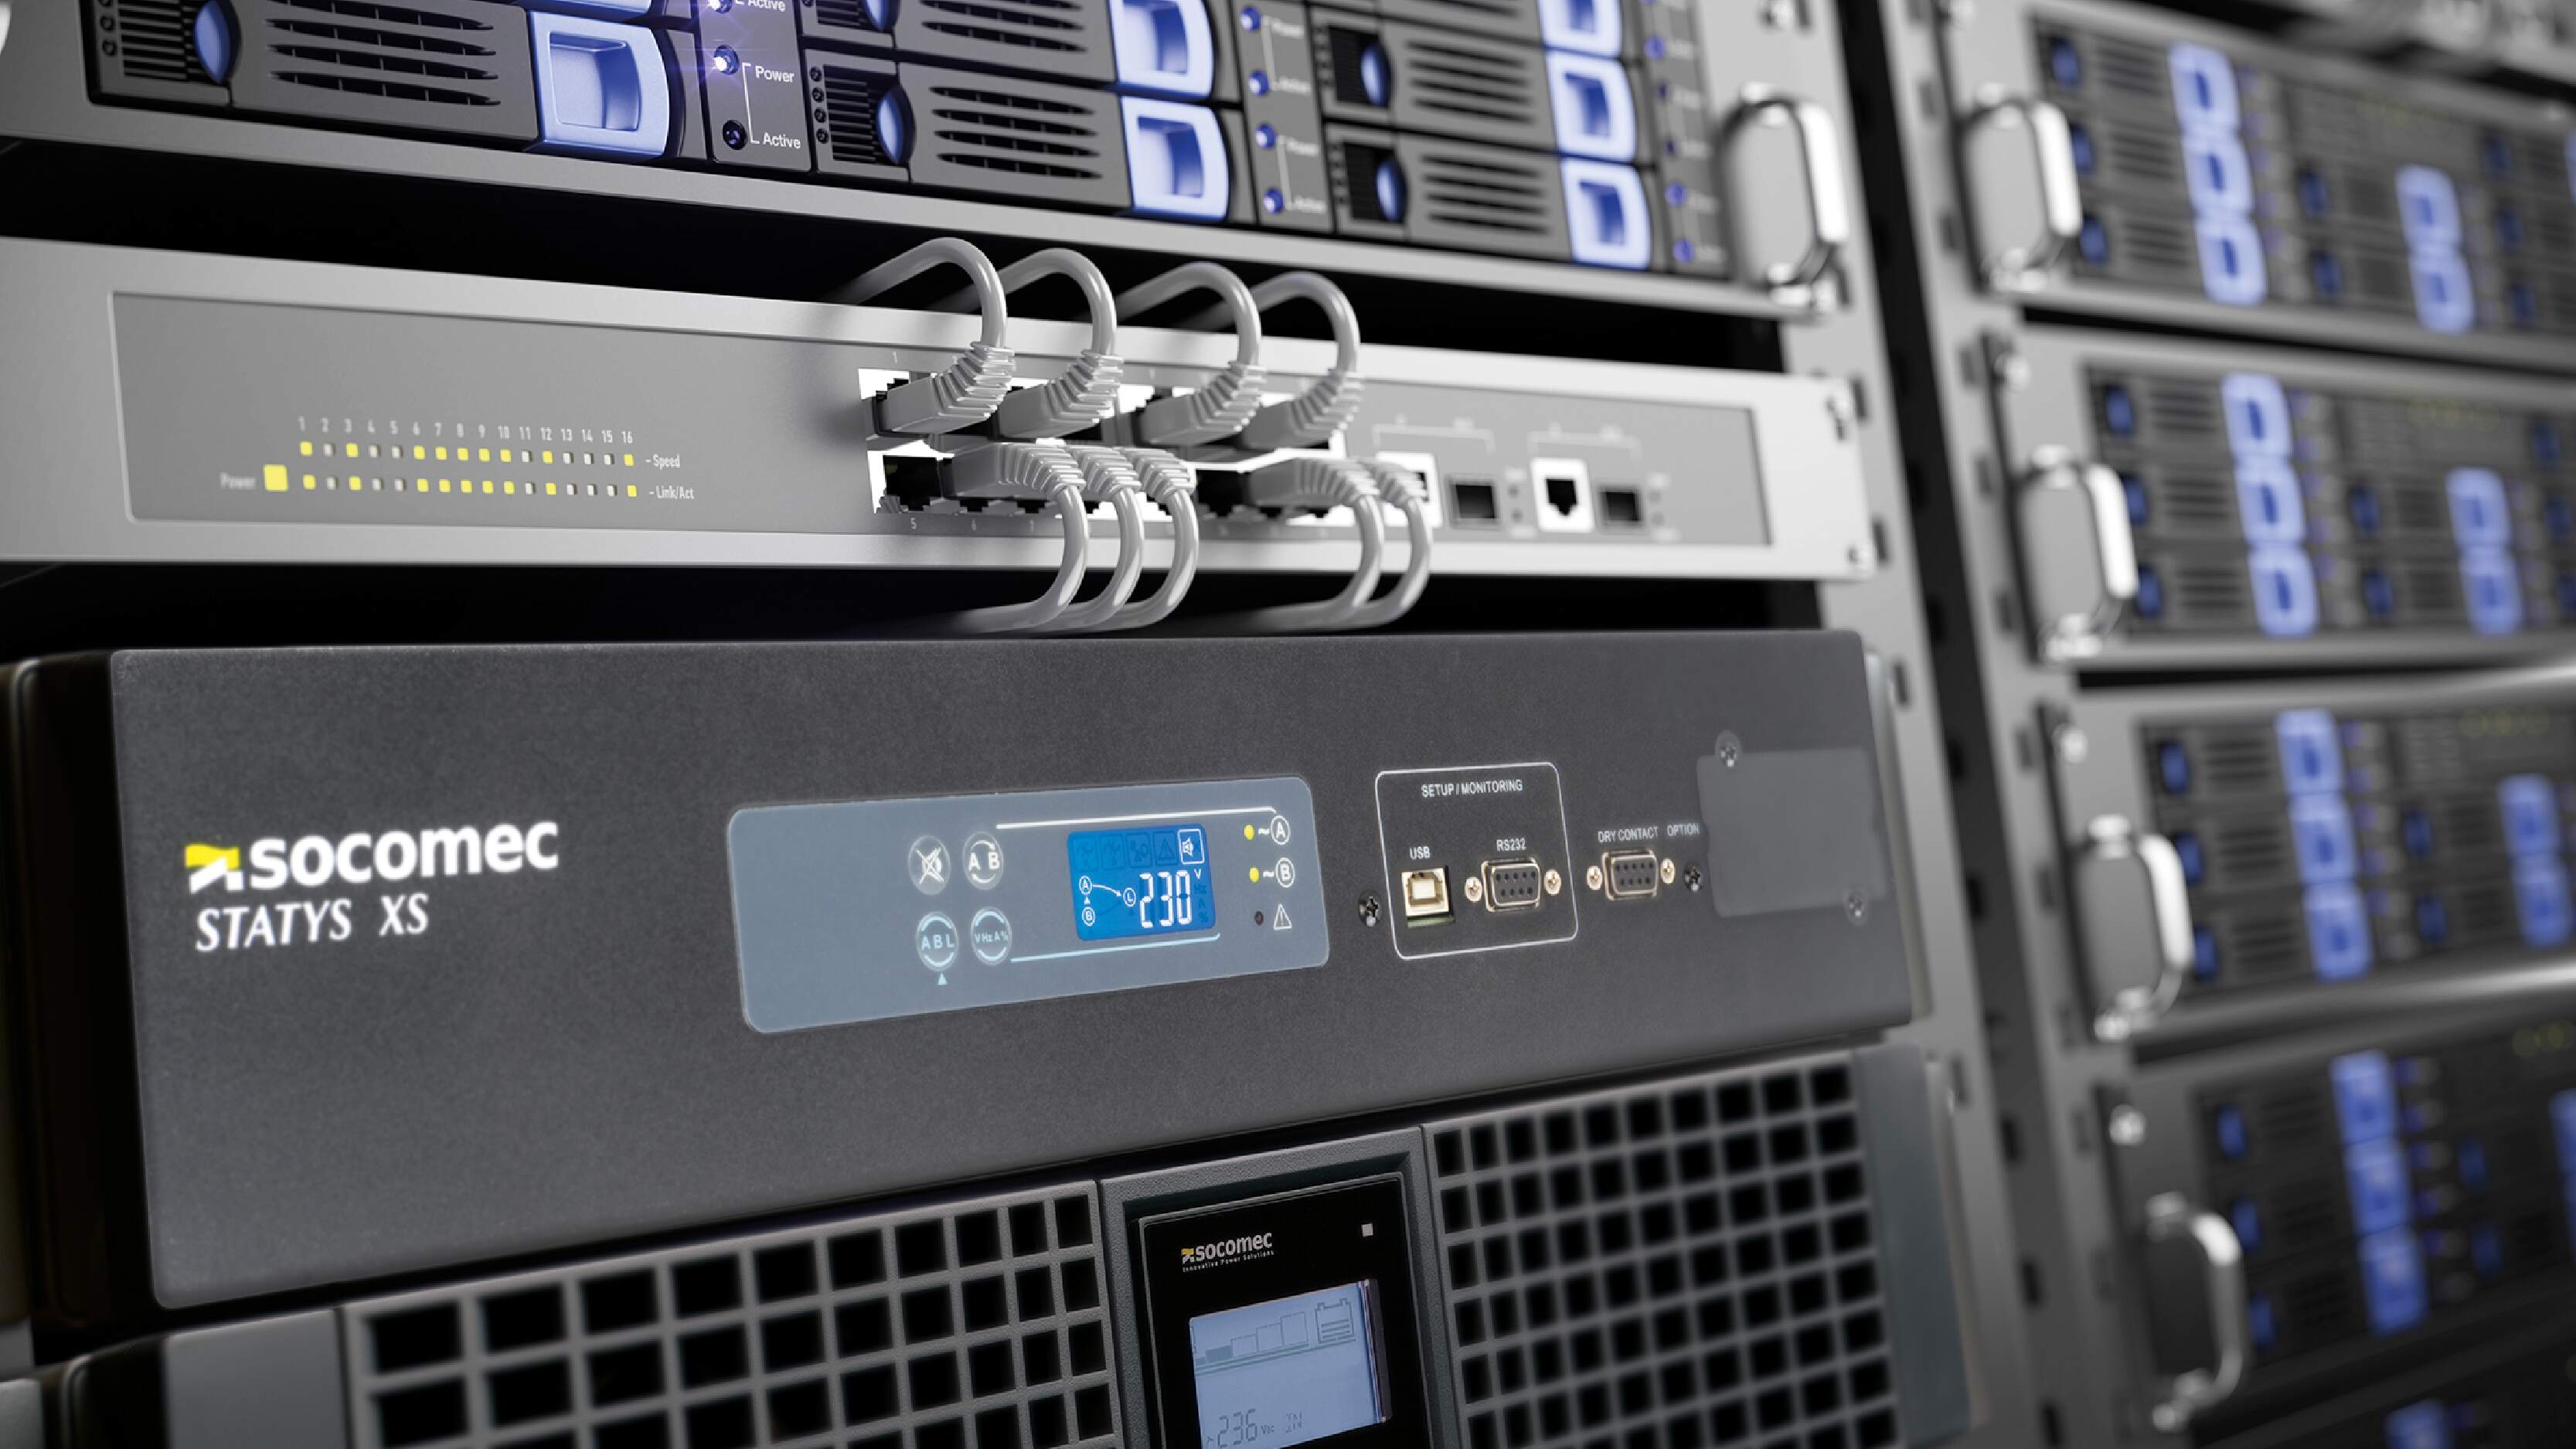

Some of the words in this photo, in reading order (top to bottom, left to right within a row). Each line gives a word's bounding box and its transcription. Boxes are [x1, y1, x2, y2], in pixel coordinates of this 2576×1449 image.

[755, 66, 795, 83] Power
[763, 132, 801, 149] Active
[298, 416, 306, 431] 1
[434, 422, 442, 437] 7
[478, 423, 485, 439] 9
[498, 425, 510, 439] 10
[519, 427, 531, 440] 11
[540, 427, 553, 441] 12
[560, 428, 573, 441] 13
[582, 429, 594, 443] 14
[602, 429, 613, 444] 15
[621, 430, 633, 444] 16
[652, 454, 681, 470] Speed
[1421, 783, 1455, 798] SETUP
[1462, 779, 1523, 794] MONITORING
[1598, 830, 1616, 842] DRY
[1618, 826, 1659, 842] CONTACT
[1666, 822, 1700, 837] OPTION
[1410, 846, 1431, 859] USB
[1496, 838, 1527, 852] RS232
[250, 821, 559, 889] socomec
[1139, 870, 1192, 929] 230
[196, 898, 352, 952] STATYS
[379, 893, 430, 937] XS
[1196, 1233, 1273, 1262] socomec
